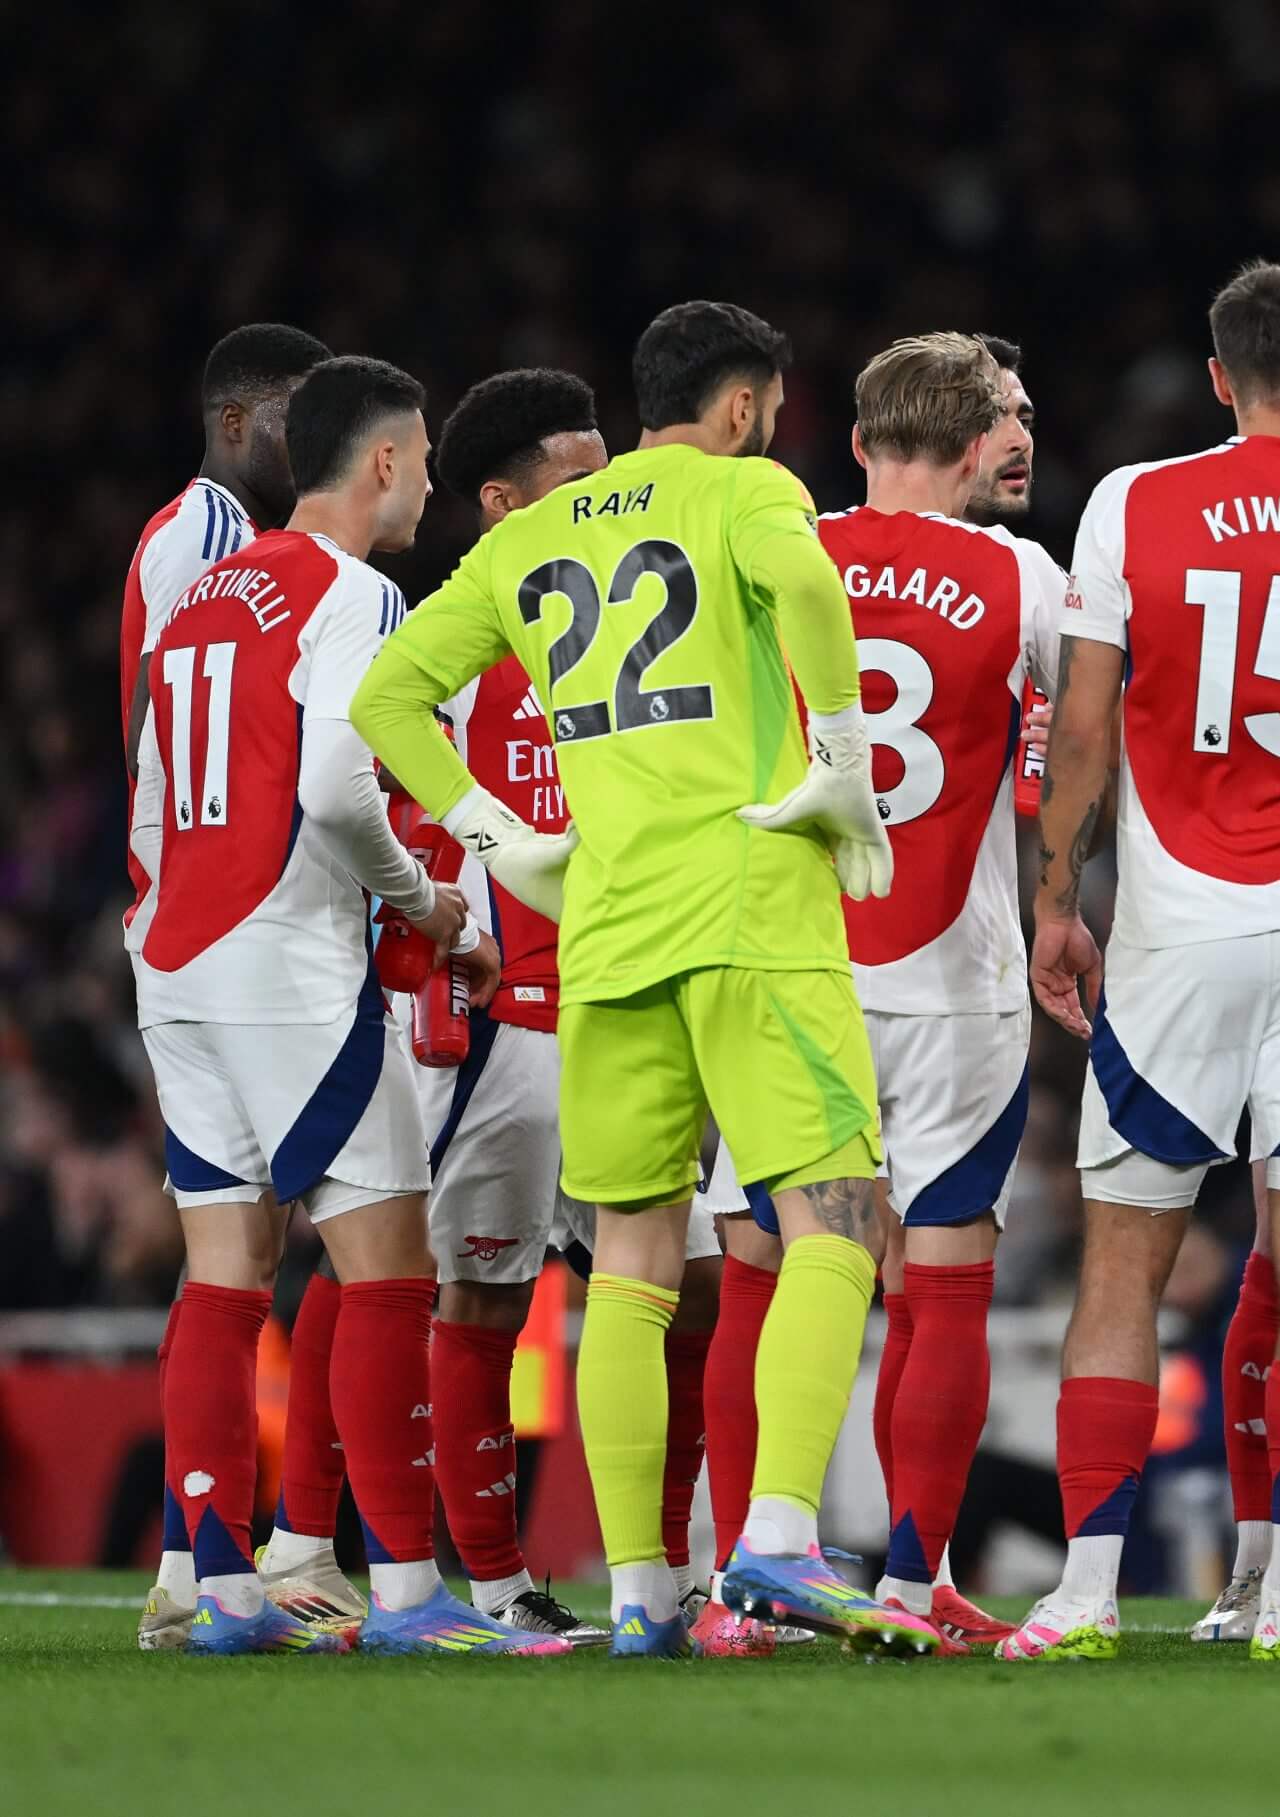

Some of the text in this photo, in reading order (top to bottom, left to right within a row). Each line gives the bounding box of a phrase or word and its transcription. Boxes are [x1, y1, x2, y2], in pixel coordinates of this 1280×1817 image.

[572, 482, 655, 525] RAYA
[166, 568, 291, 633] ARTINELLI
[844, 564, 985, 630] GAARD
[517, 539, 715, 744] 22
[162, 641, 238, 831] 11
[854, 637, 945, 828] 8
[476, 1432, 516, 1452] AF
